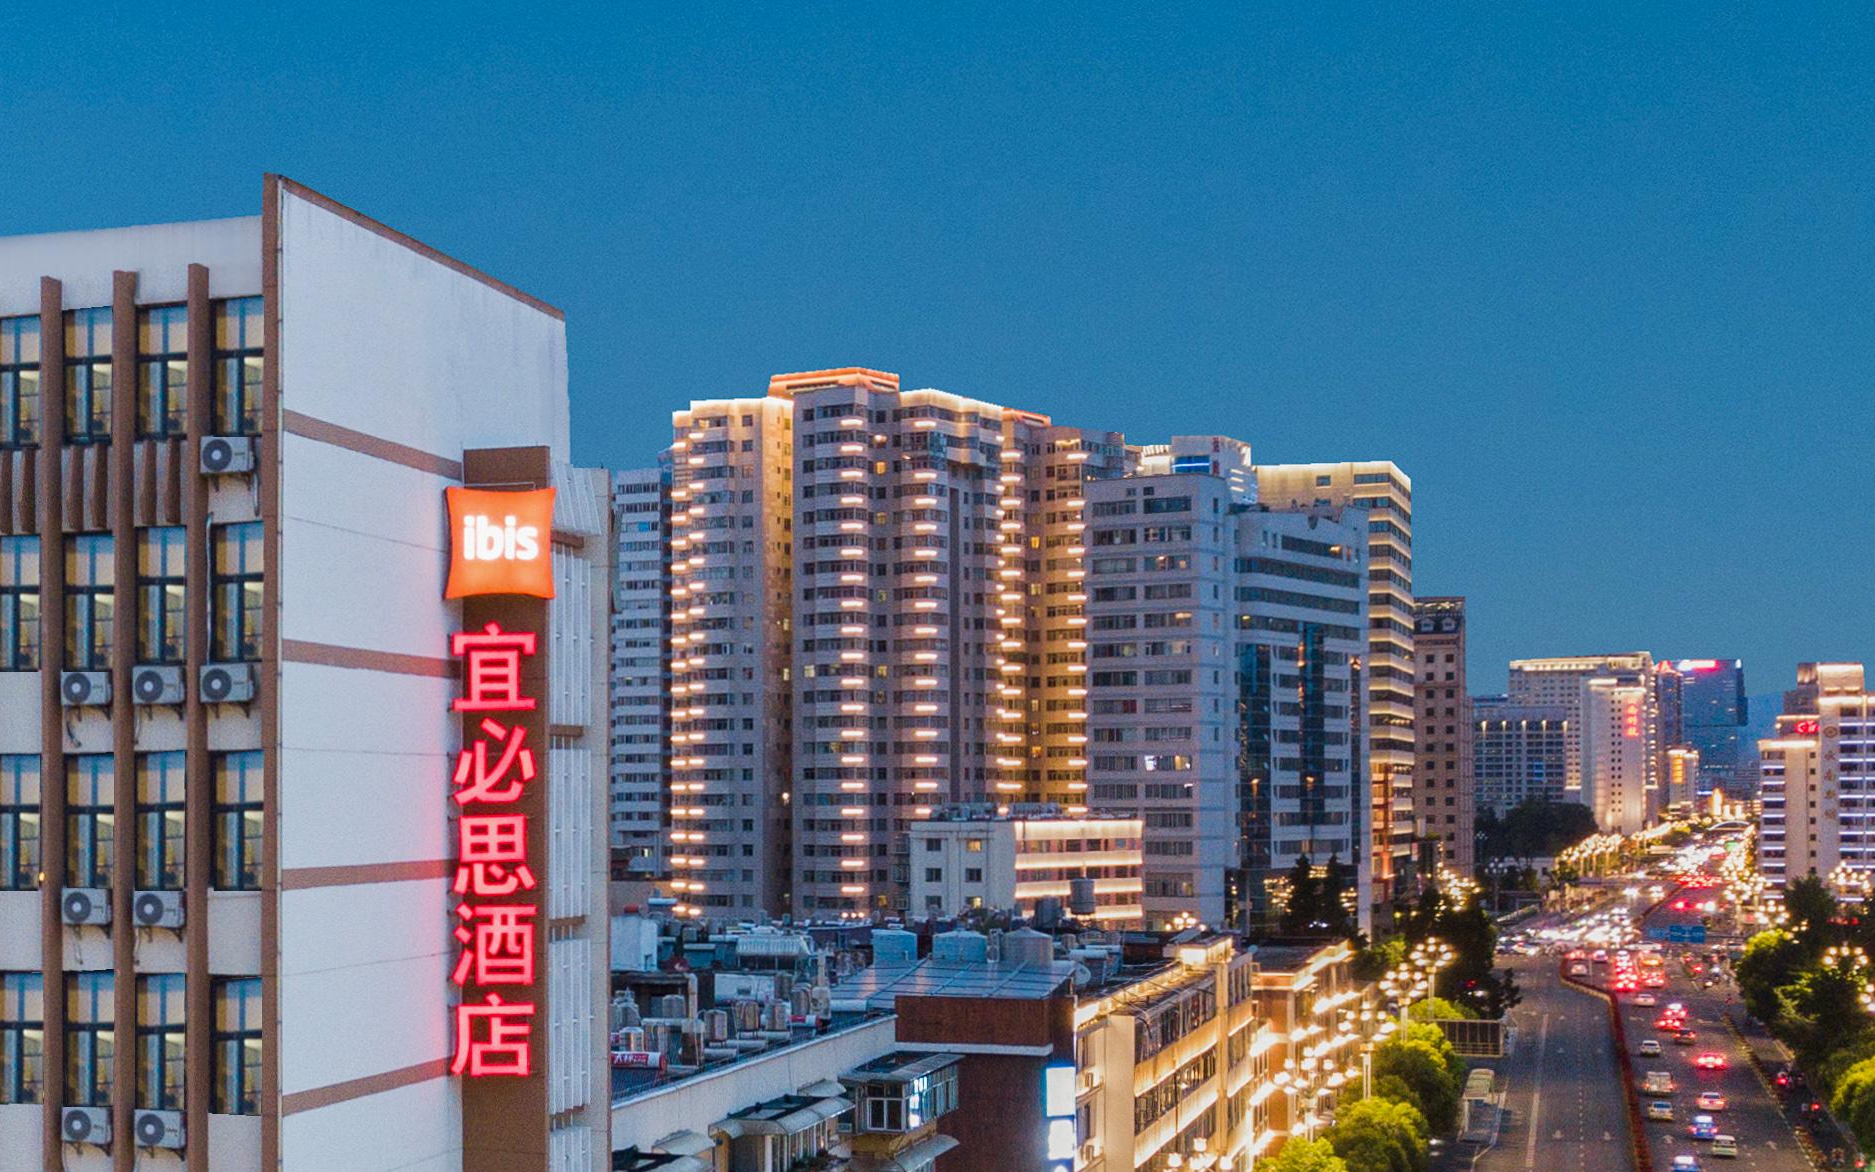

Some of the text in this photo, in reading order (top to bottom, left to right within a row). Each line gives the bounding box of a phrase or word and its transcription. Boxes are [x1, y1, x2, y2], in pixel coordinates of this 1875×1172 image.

[462, 514, 540, 562] ibis
[450, 622, 537, 1079] 宜必思酒店
